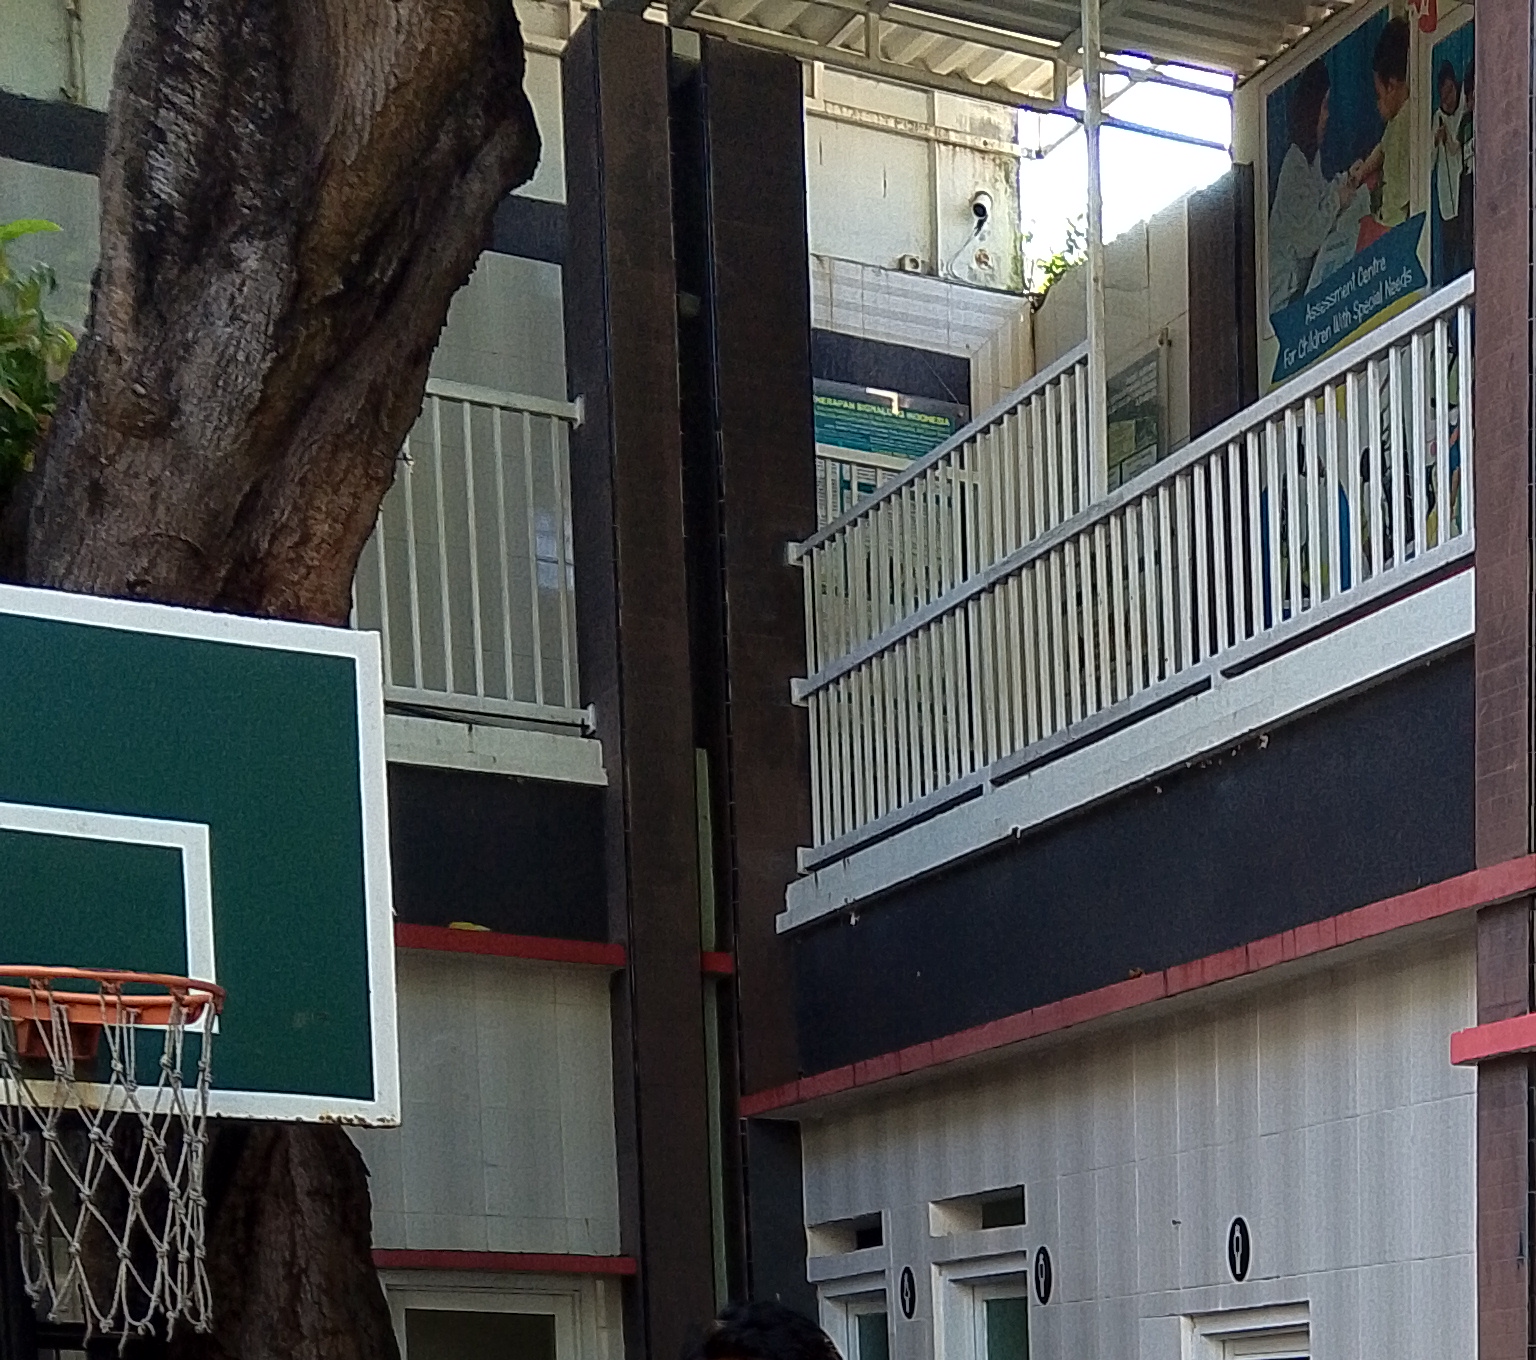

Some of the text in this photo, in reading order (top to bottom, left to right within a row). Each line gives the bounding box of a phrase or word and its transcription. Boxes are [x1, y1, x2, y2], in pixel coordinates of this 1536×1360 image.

[1283, 266, 1413, 370] For Children With Special Needs
[1305, 256, 1386, 325] Assessment Centre
